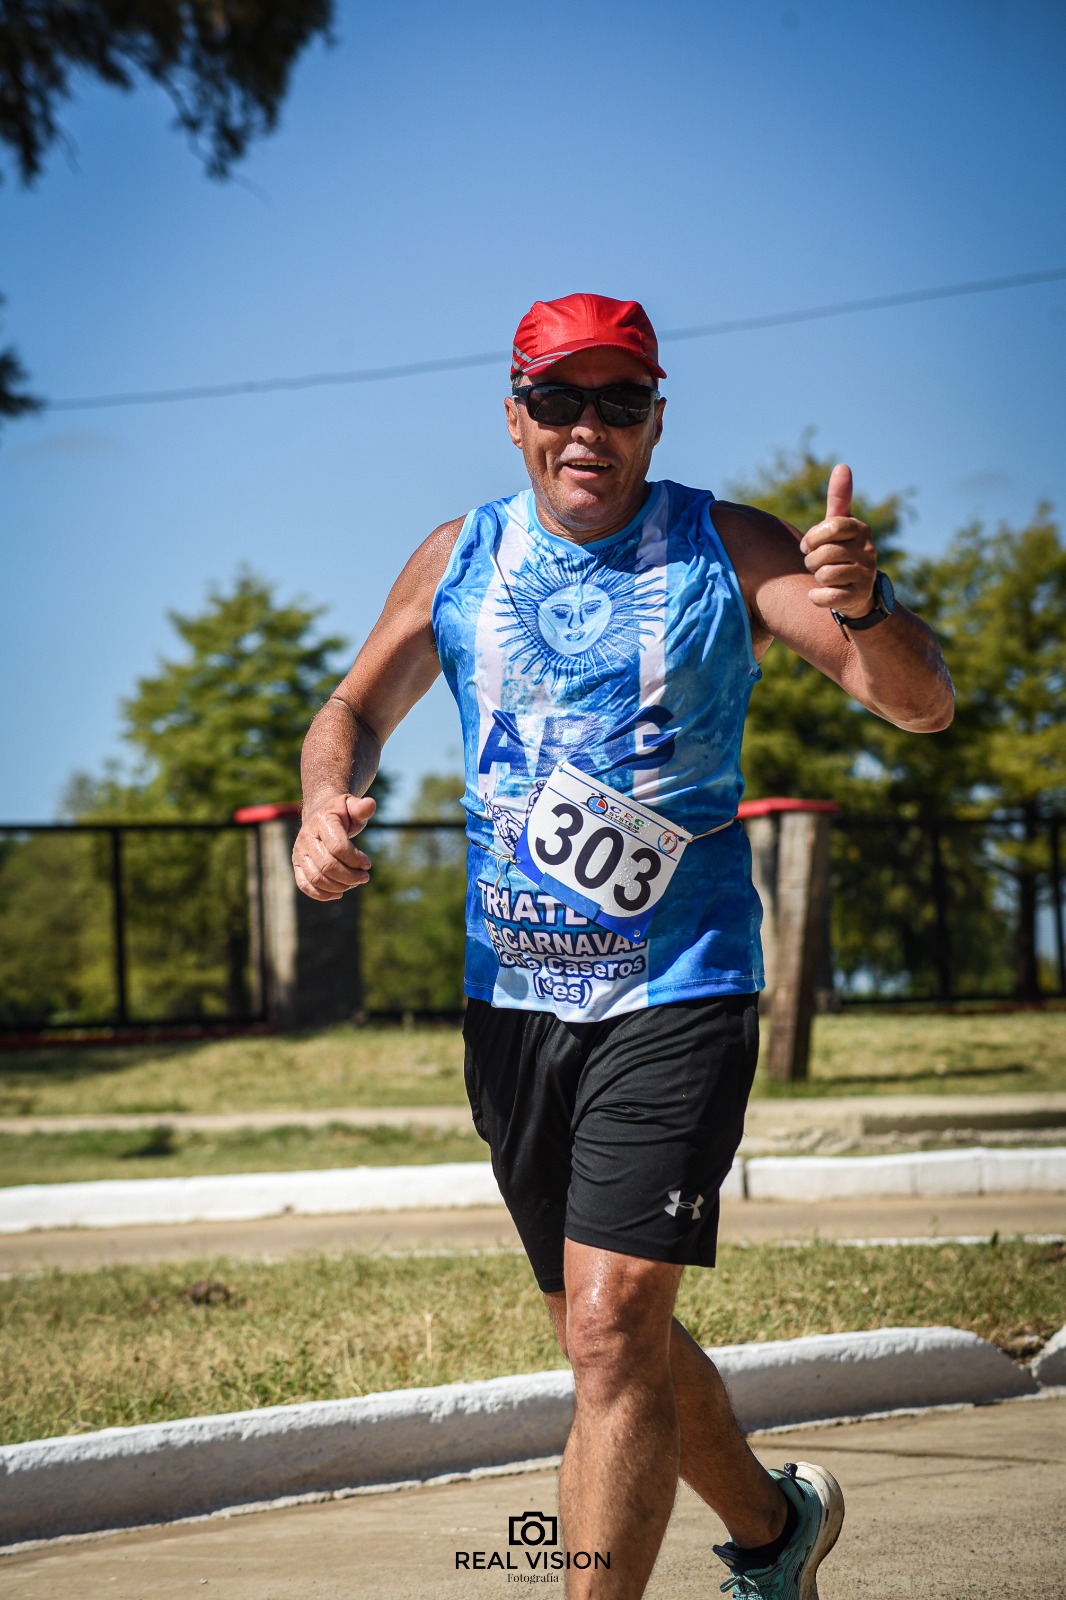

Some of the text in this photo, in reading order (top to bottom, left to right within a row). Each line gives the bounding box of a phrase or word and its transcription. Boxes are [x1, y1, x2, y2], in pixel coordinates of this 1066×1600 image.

[478, 704, 678, 777] ARG
[608, 811, 640, 831] SYSTEM
[535, 802, 662, 911] 303
[477, 879, 589, 927] TRIATL
[544, 956, 646, 981] Caseros
